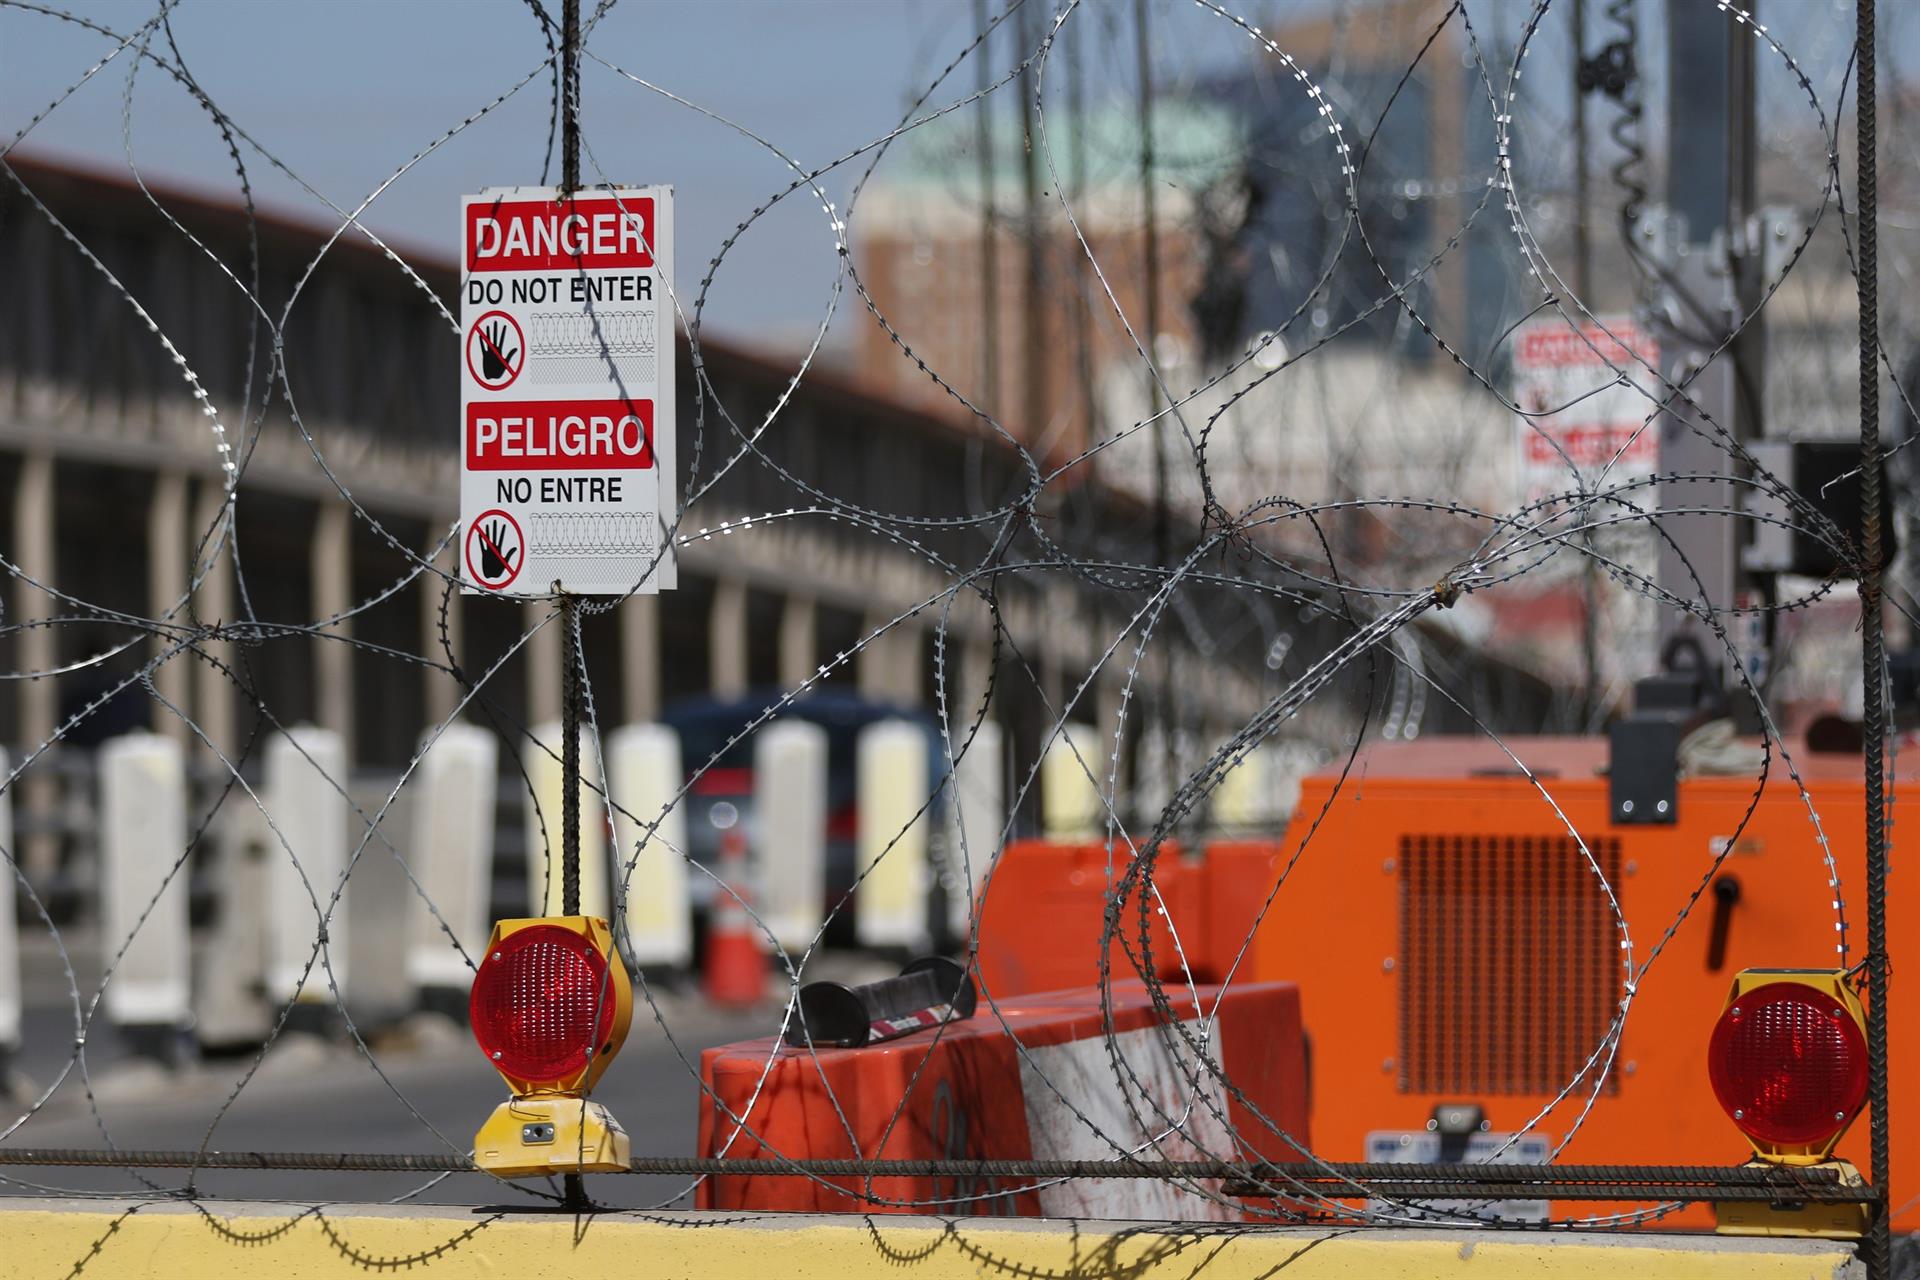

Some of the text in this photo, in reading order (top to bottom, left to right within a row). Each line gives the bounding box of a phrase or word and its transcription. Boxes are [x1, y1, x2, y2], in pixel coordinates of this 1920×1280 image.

[476, 212, 645, 258] DANGER
[469, 275, 652, 305] DO NOT ENTER
[476, 414, 645, 457] PELIGRO
[497, 477, 622, 504] NO ENTRE
